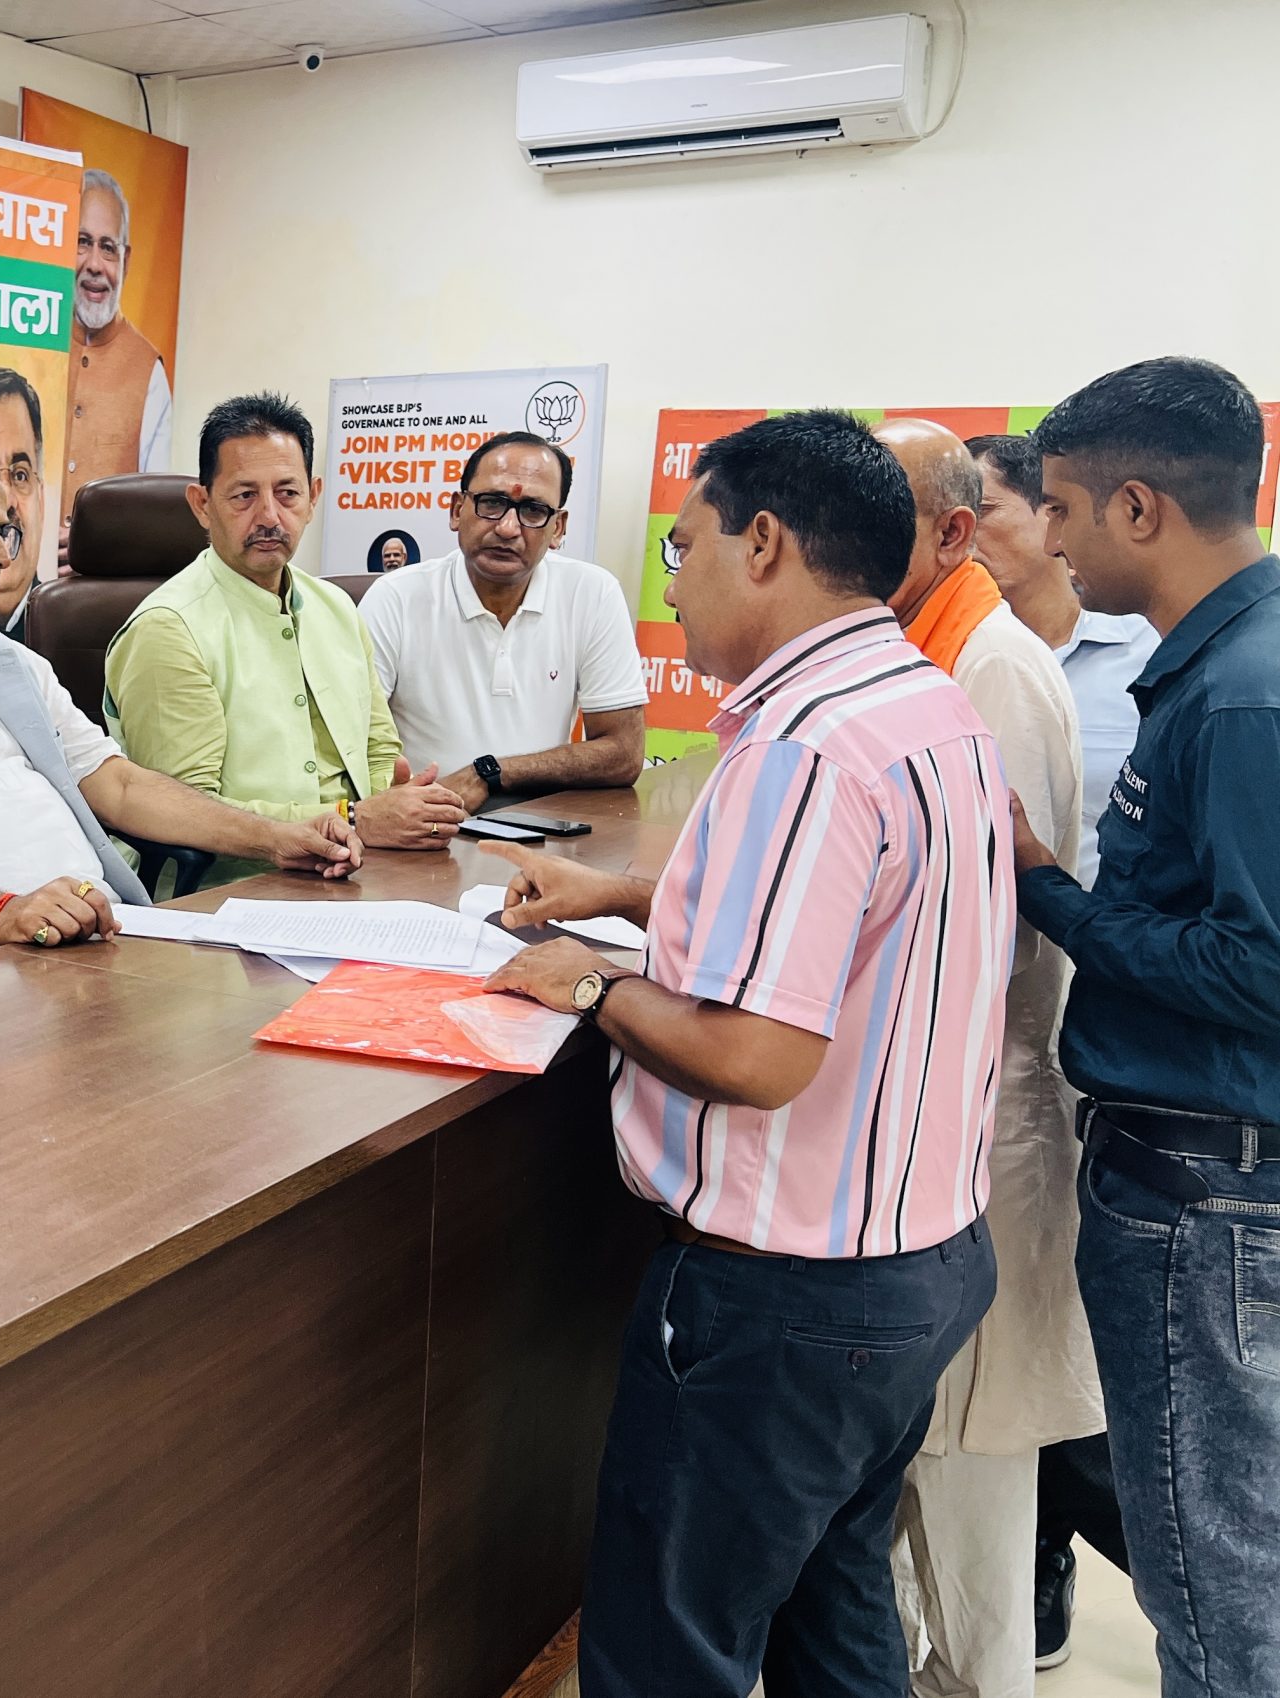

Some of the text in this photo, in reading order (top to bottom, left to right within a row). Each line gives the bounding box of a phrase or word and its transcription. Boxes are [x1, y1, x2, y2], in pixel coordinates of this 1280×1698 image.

[342, 403, 422, 415] SHOWCASE BJP'S
[341, 414, 488, 429] GOVERNANCE TO ONE AND ALL
[340, 435, 389, 454] JOIN
[394, 434, 425, 452] PM
[339, 460, 436, 484] 'VIKSIT
[337, 491, 432, 510] CLARION
